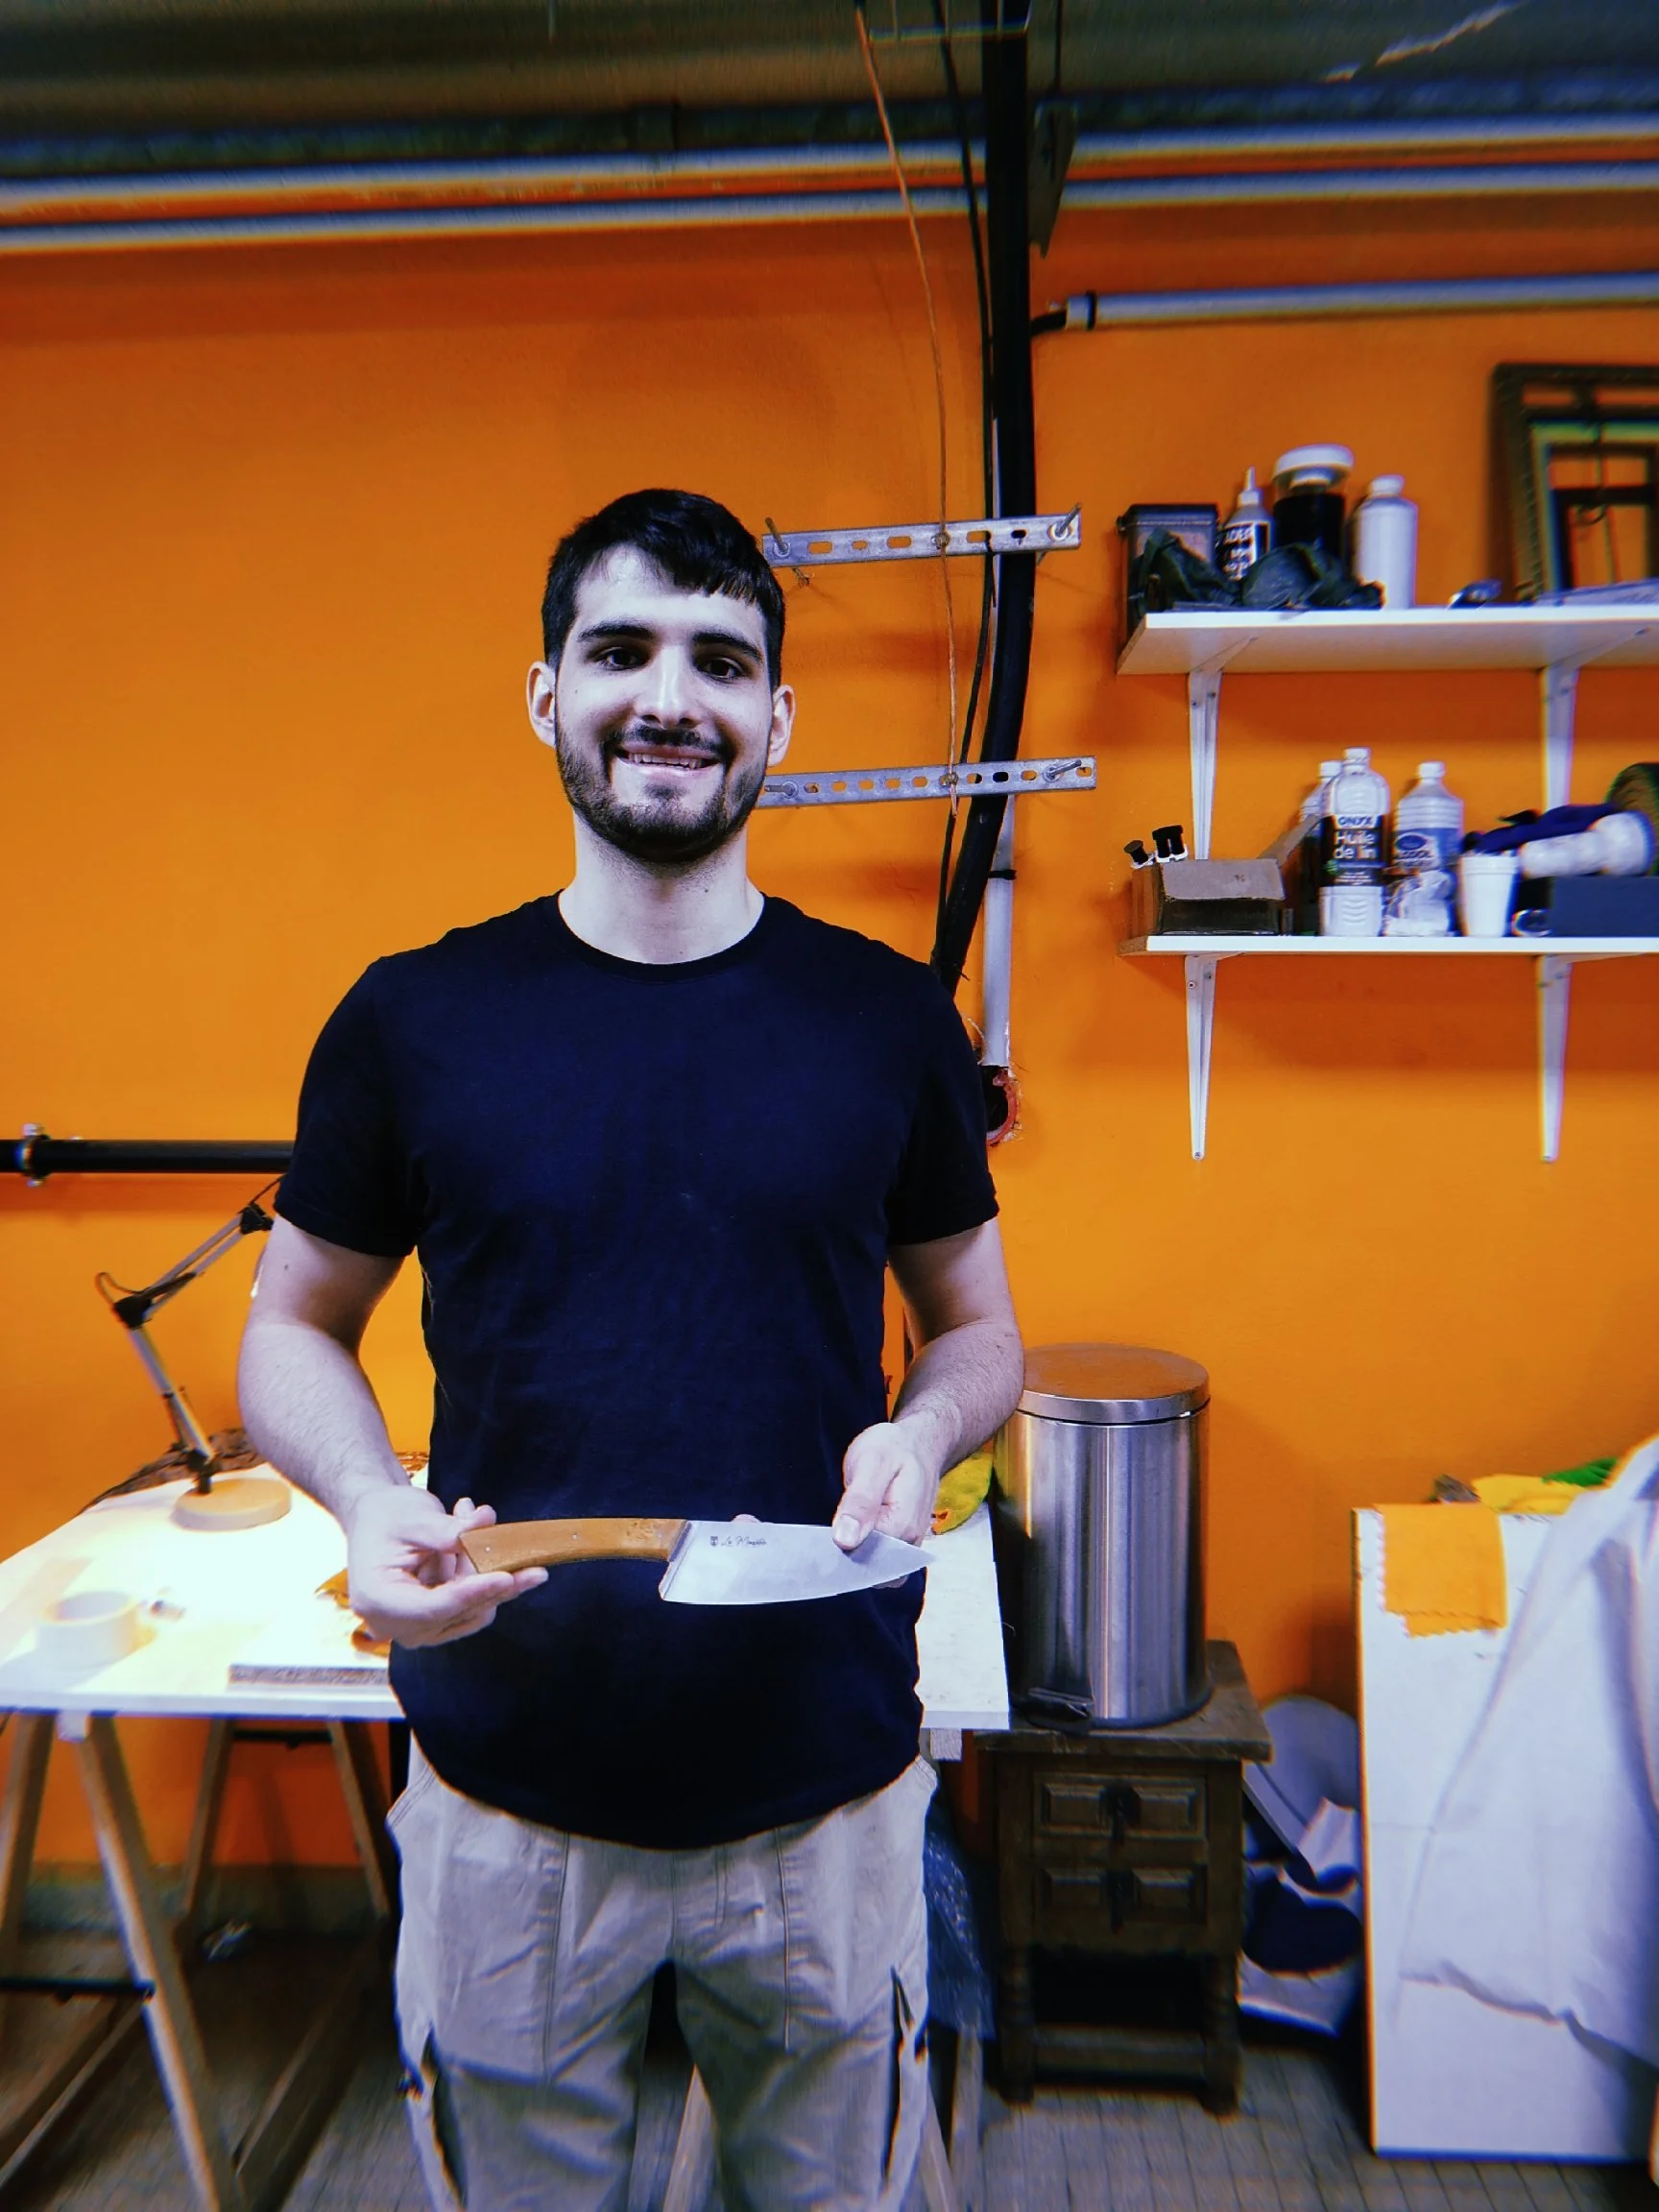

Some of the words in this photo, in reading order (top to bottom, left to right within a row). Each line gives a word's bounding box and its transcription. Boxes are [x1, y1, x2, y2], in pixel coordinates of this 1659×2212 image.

[1337, 816, 1373, 826] ONYX
[1334, 830, 1375, 845] Huile
[1334, 844, 1354, 858] de
[1357, 844, 1377, 859] lin
